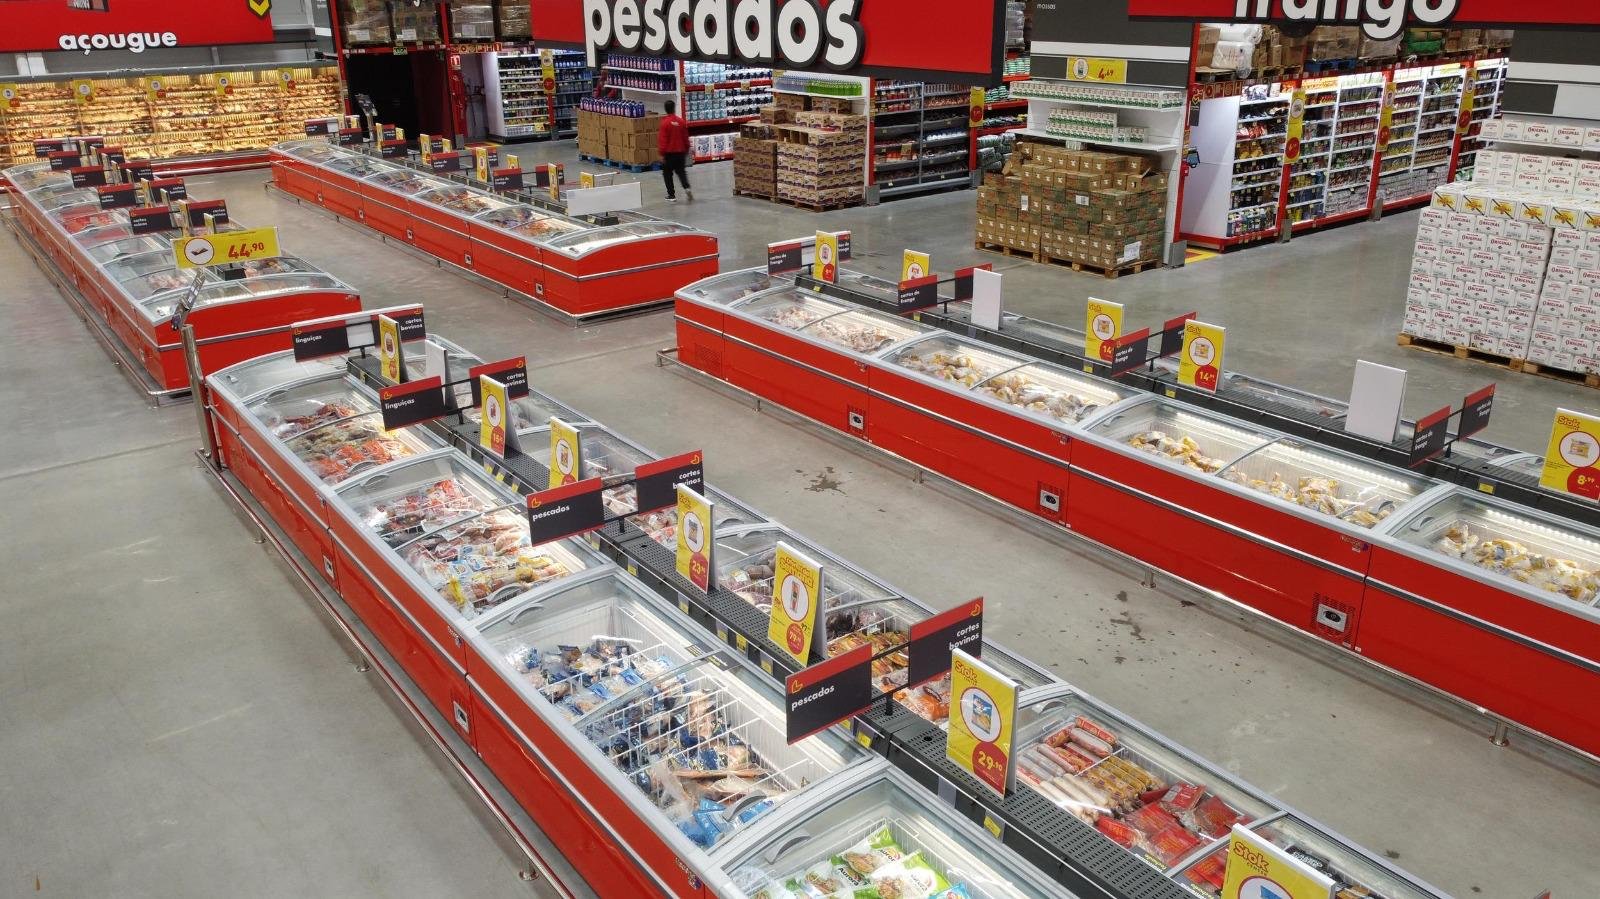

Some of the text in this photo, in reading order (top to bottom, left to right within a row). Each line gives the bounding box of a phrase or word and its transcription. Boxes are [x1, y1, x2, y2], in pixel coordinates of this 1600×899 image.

[59, 32, 176, 54] açougue
[584, 0, 858, 68] pescados
[385, 399, 414, 410] linguiças
[673, 477, 700, 489] binos
[679, 469, 700, 479] cortes
[532, 505, 570, 521] pescados
[956, 622, 979, 636] cortes
[949, 633, 979, 650] bovinos
[955, 660, 977, 681] Stok
[791, 685, 835, 712] pescados
[1233, 841, 1269, 870] Stok
[838, 867, 860, 886] Aurora
